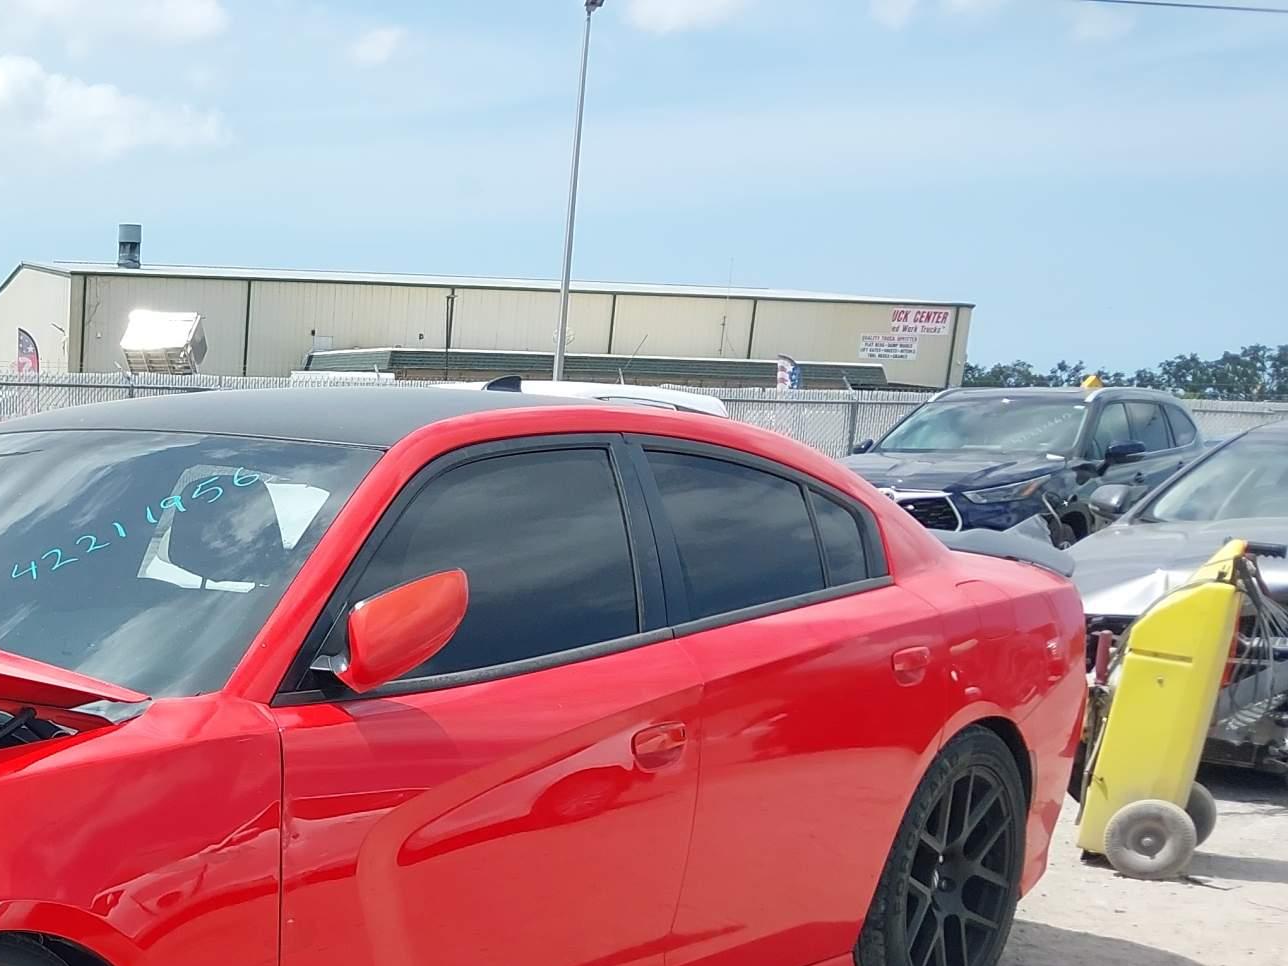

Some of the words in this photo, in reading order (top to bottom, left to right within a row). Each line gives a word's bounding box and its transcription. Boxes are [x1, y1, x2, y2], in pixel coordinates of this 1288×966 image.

[913, 310, 949, 324] CENTER
[902, 324, 918, 332] Work
[11, 467, 259, 580] 42211956
